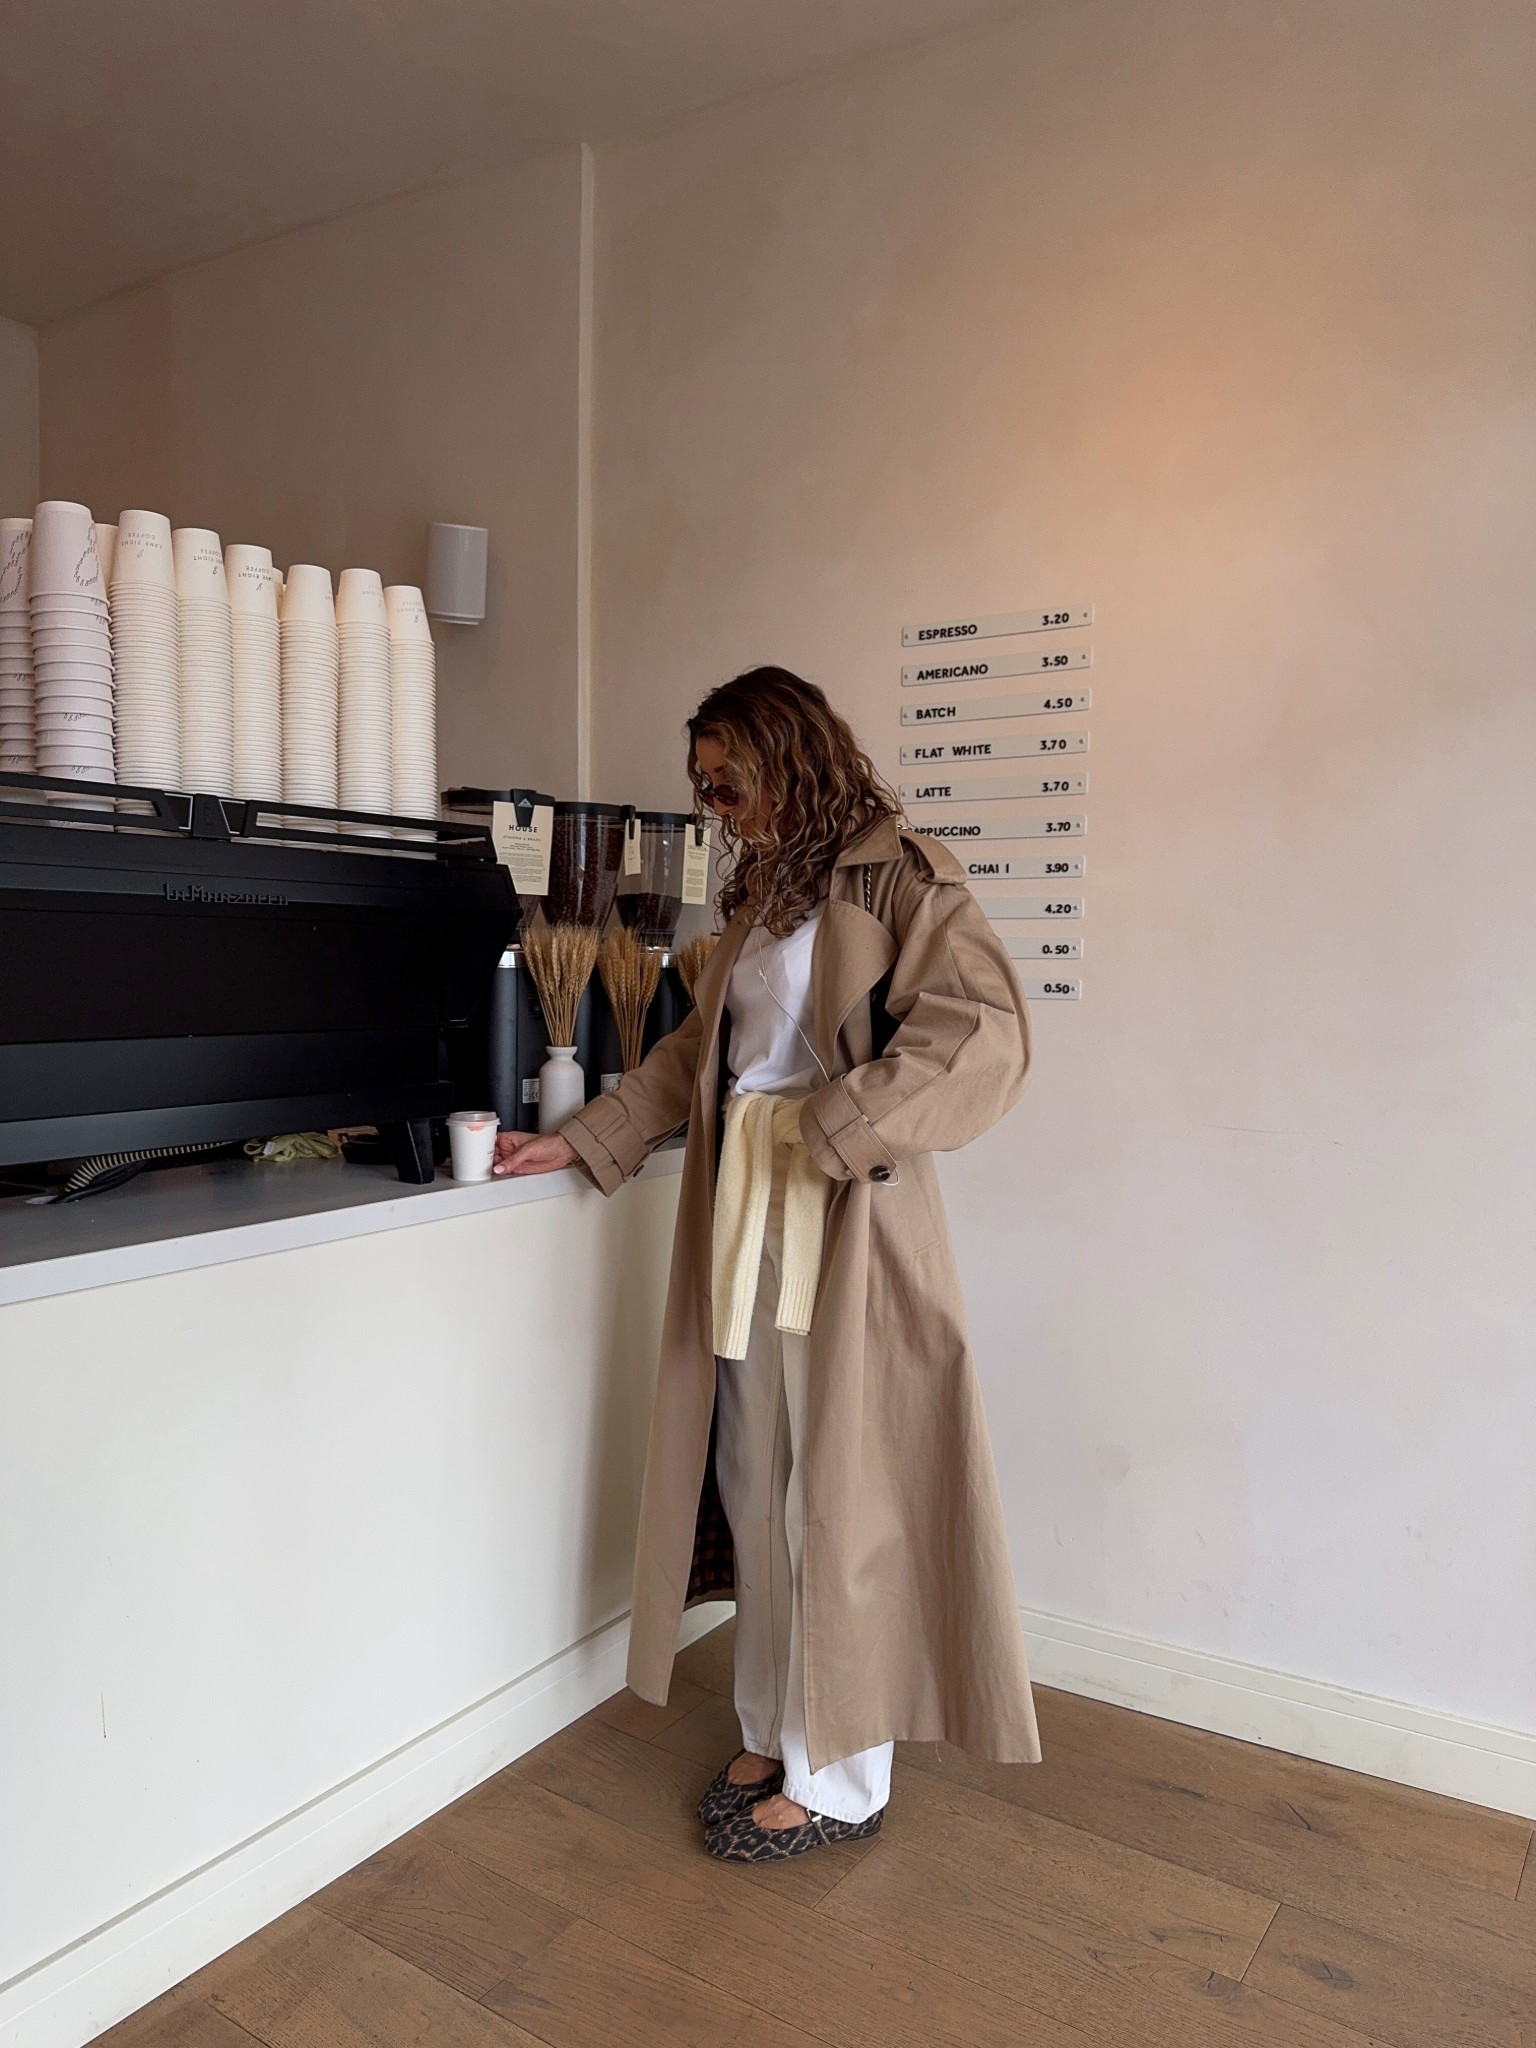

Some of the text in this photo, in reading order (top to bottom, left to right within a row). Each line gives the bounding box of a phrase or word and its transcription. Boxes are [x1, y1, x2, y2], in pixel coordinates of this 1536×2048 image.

[918, 613, 1070, 641] ESPRESSO 3.20
[916, 655, 1069, 681] AMERICANO 3.50
[915, 698, 1073, 720] BATCH 4.50
[914, 739, 1067, 759] FLAT WHITE 3.70
[915, 781, 1070, 799] LATTE 3.70
[508, 824, 538, 833] HOUSE
[913, 821, 1071, 837] APPUCCINO 3.70
[968, 863, 1000, 875] CHAI
[1045, 862, 1070, 874] 3.90
[1044, 903, 1072, 914] 4.20
[1041, 944, 1070, 955] 0.50
[1043, 983, 1070, 995] 0.50
